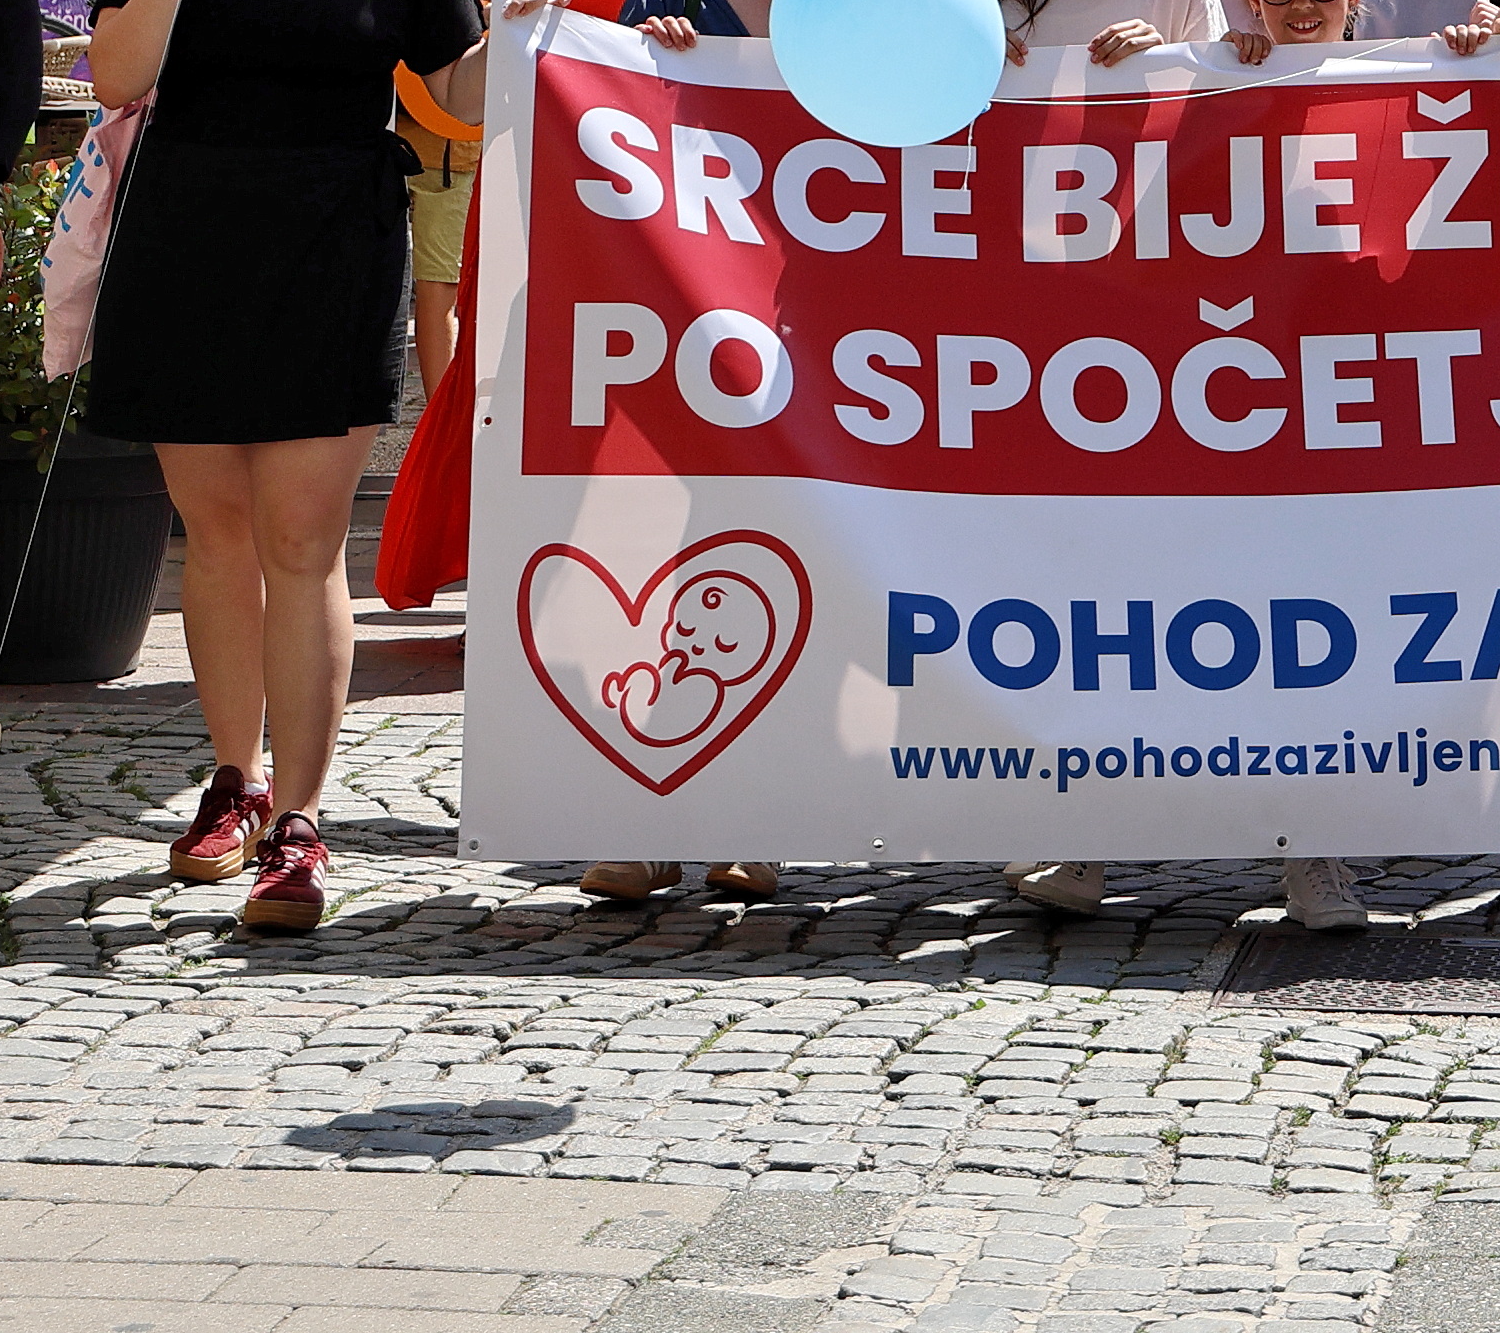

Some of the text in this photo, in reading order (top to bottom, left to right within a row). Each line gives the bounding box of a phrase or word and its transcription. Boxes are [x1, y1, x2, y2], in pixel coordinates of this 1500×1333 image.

[575, 106, 978, 261] SRCE
[1023, 132, 1361, 263] BIJE
[571, 301, 794, 429] PO
[887, 590, 1358, 691] POHOD
